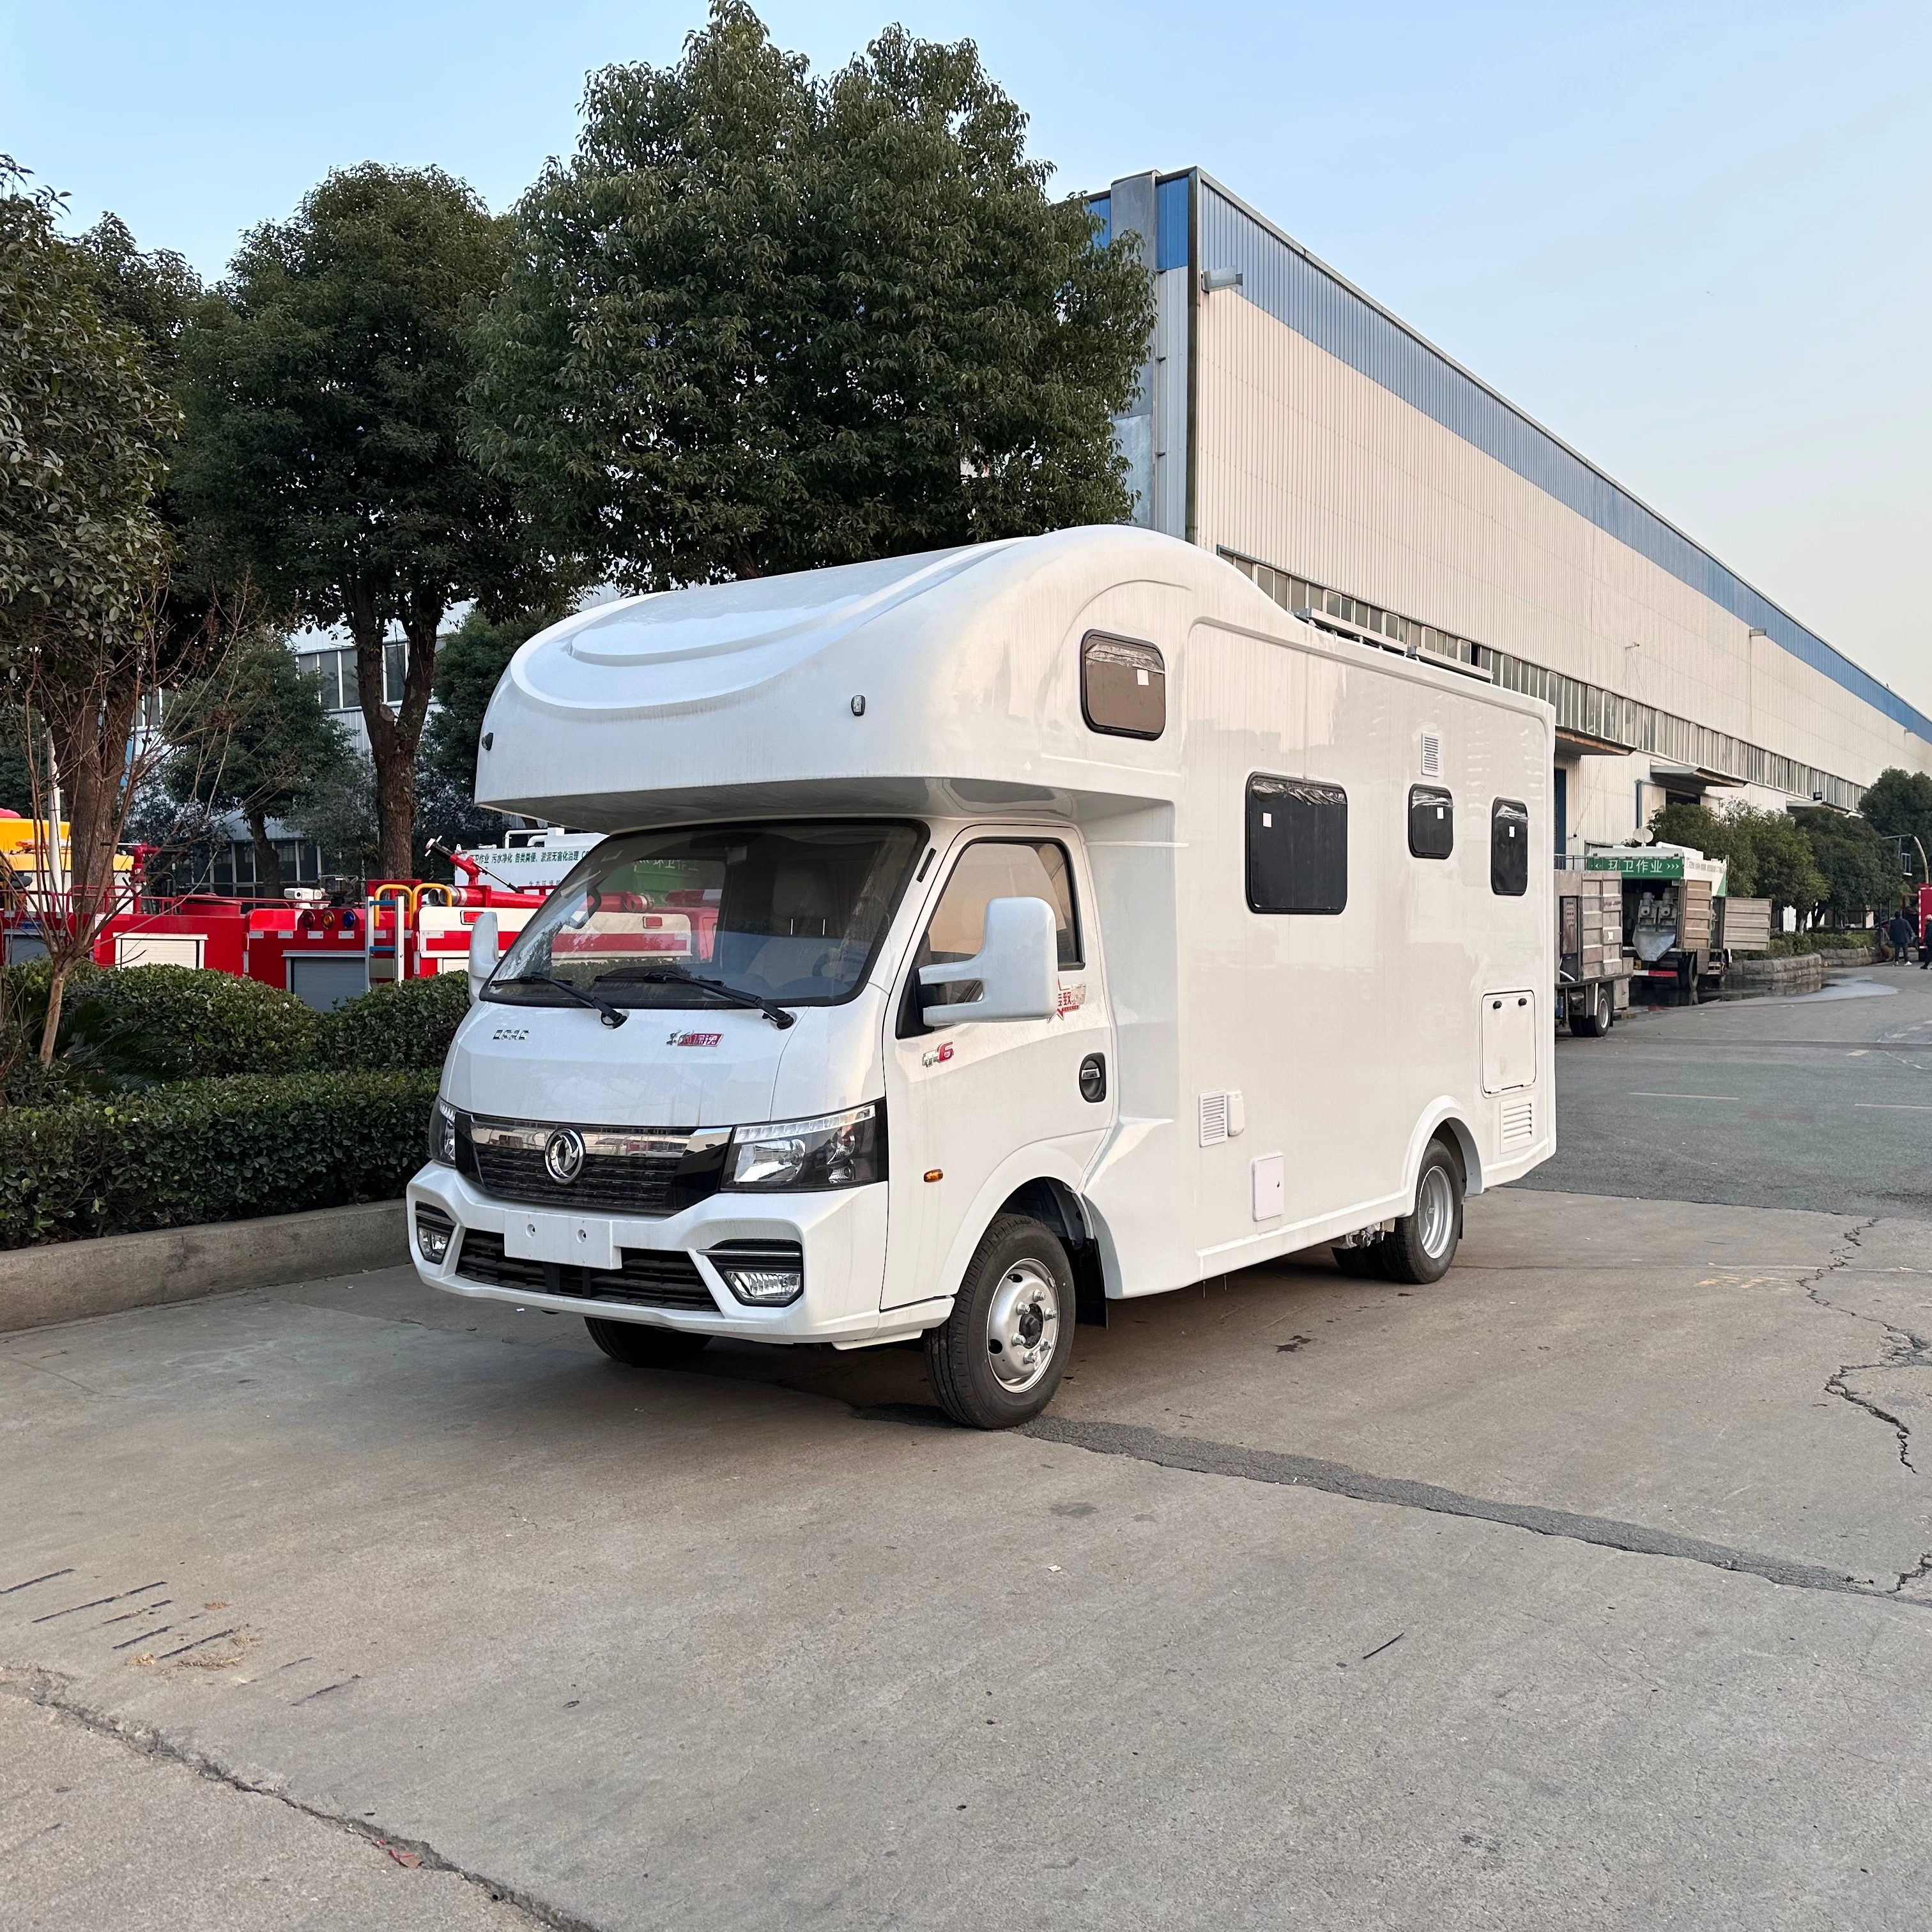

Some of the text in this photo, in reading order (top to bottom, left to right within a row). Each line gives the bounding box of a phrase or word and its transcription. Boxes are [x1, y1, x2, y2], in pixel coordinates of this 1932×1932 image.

[469, 853, 490, 864] 卫作业
[491, 852, 512, 864] 污水净化
[1608, 859, 1662, 873] 环卫作业
